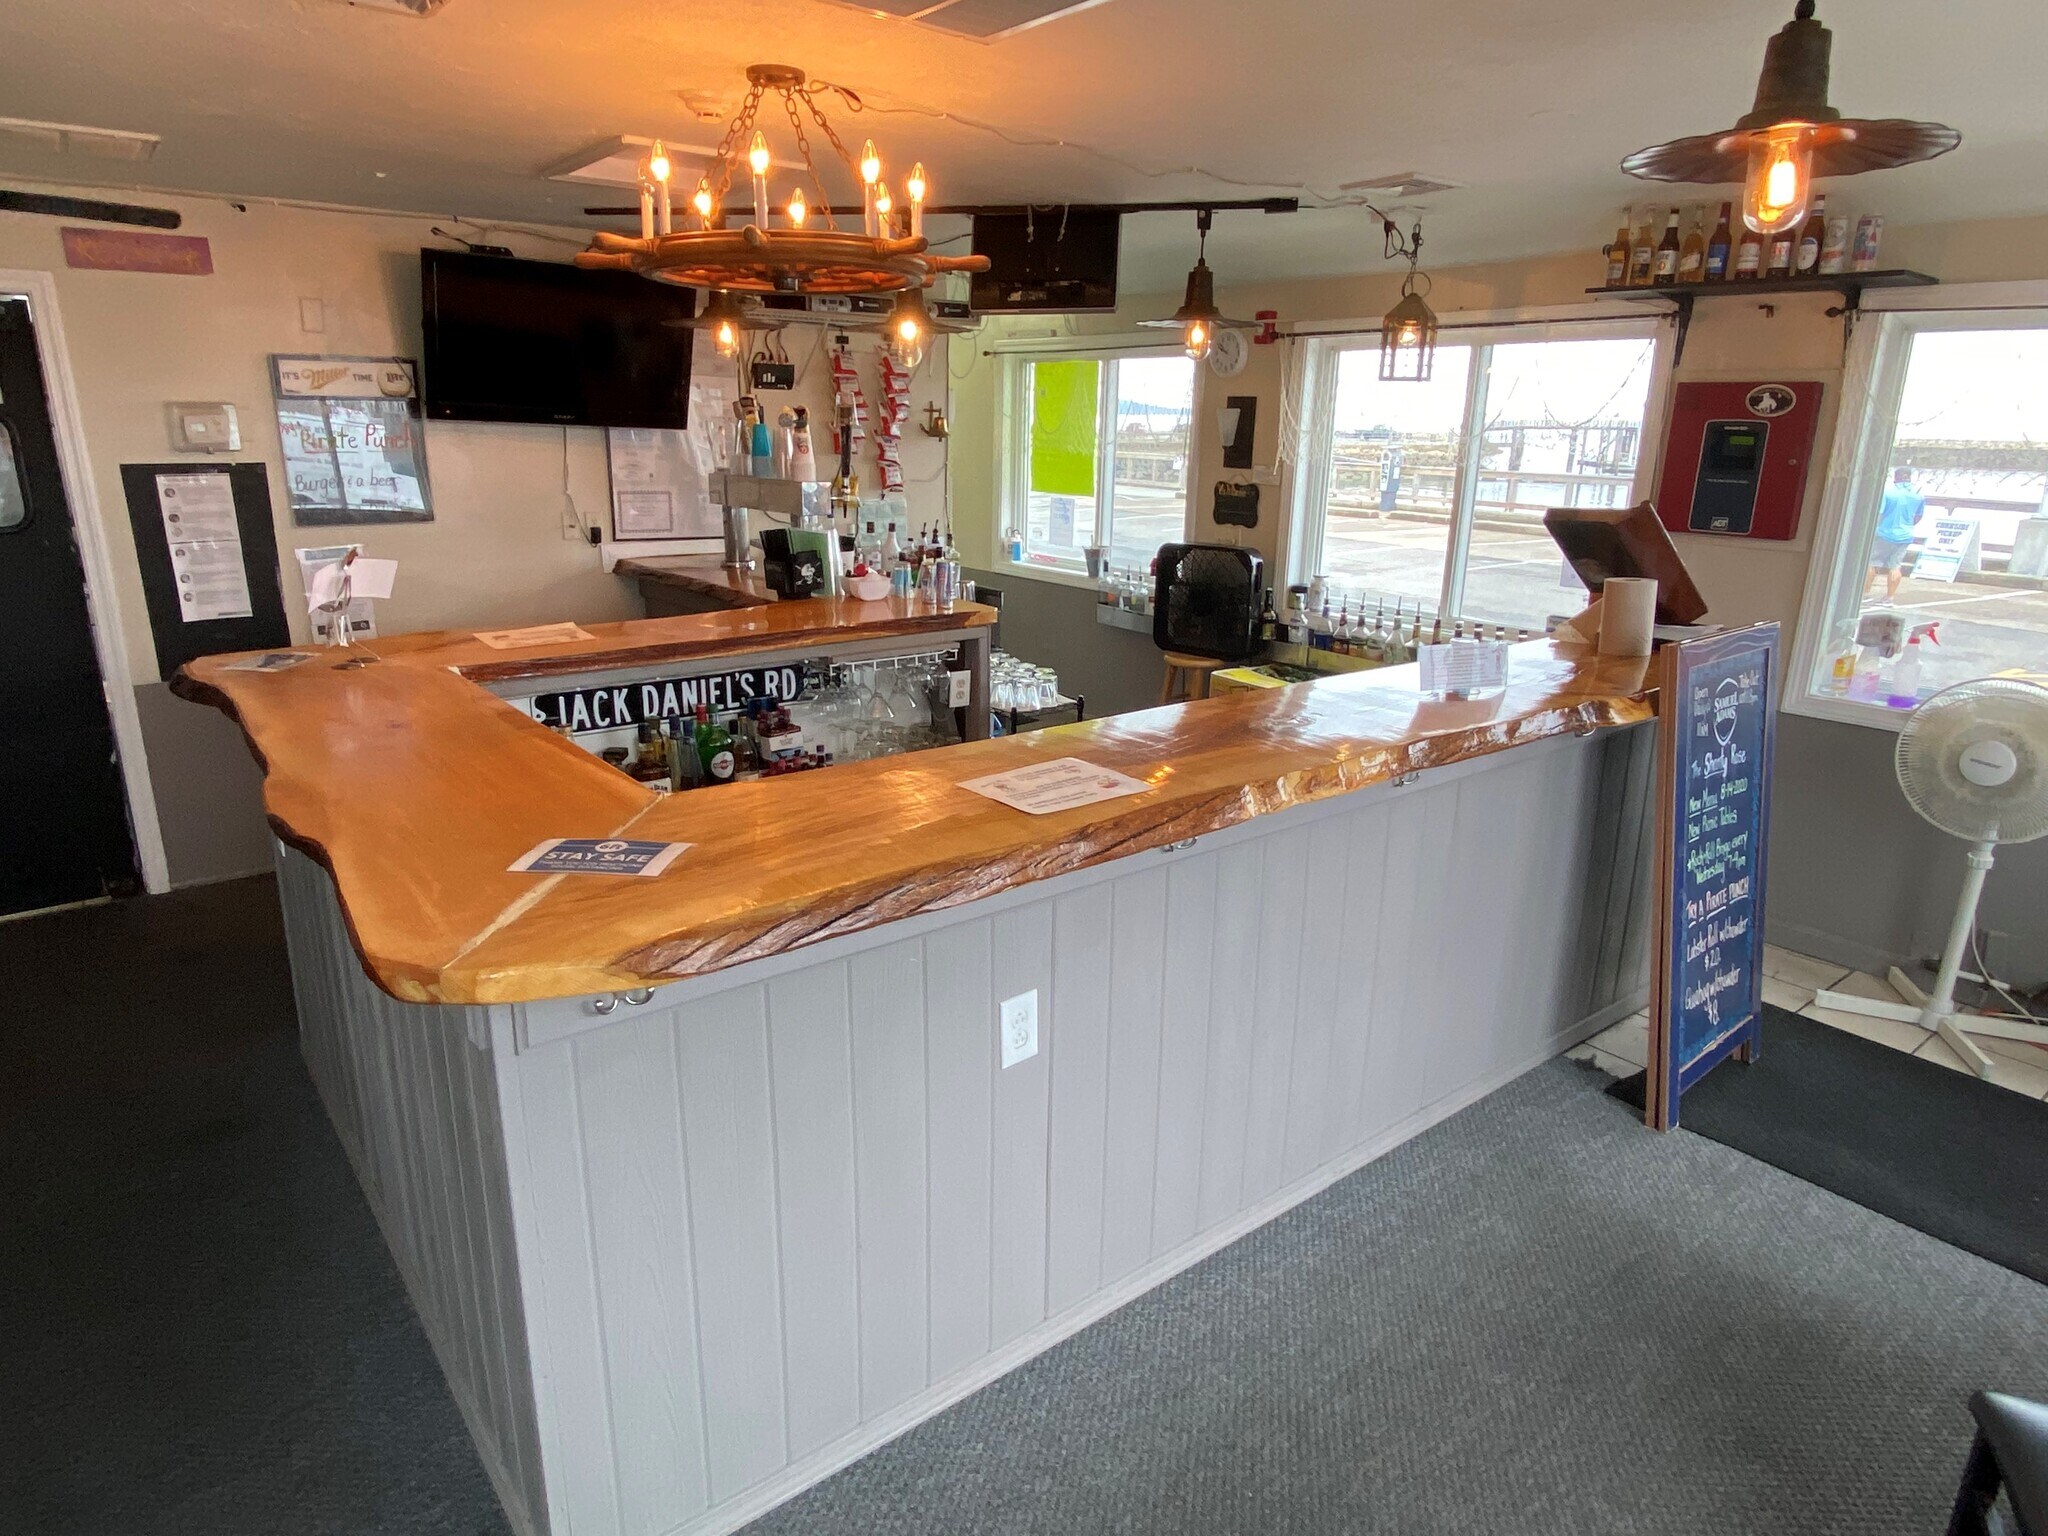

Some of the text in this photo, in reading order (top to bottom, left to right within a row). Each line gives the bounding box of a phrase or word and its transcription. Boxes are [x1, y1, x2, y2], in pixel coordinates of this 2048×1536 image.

[281, 371, 299, 381] IT'S
[300, 366, 350, 391] Miller
[352, 373, 374, 383] TIME
[300, 426, 358, 449] Pirate
[365, 421, 415, 448] Punch
[356, 477, 364, 487] a
[558, 667, 797, 731] JACK DANIEL'S RD
[1713, 691, 1739, 713] SAMUEL
[1715, 706, 1737, 723] ADAMS
[544, 851, 654, 863] STAY SAFE
[1698, 899, 1704, 916] A
[1705, 887, 1728, 912] PIRATE
